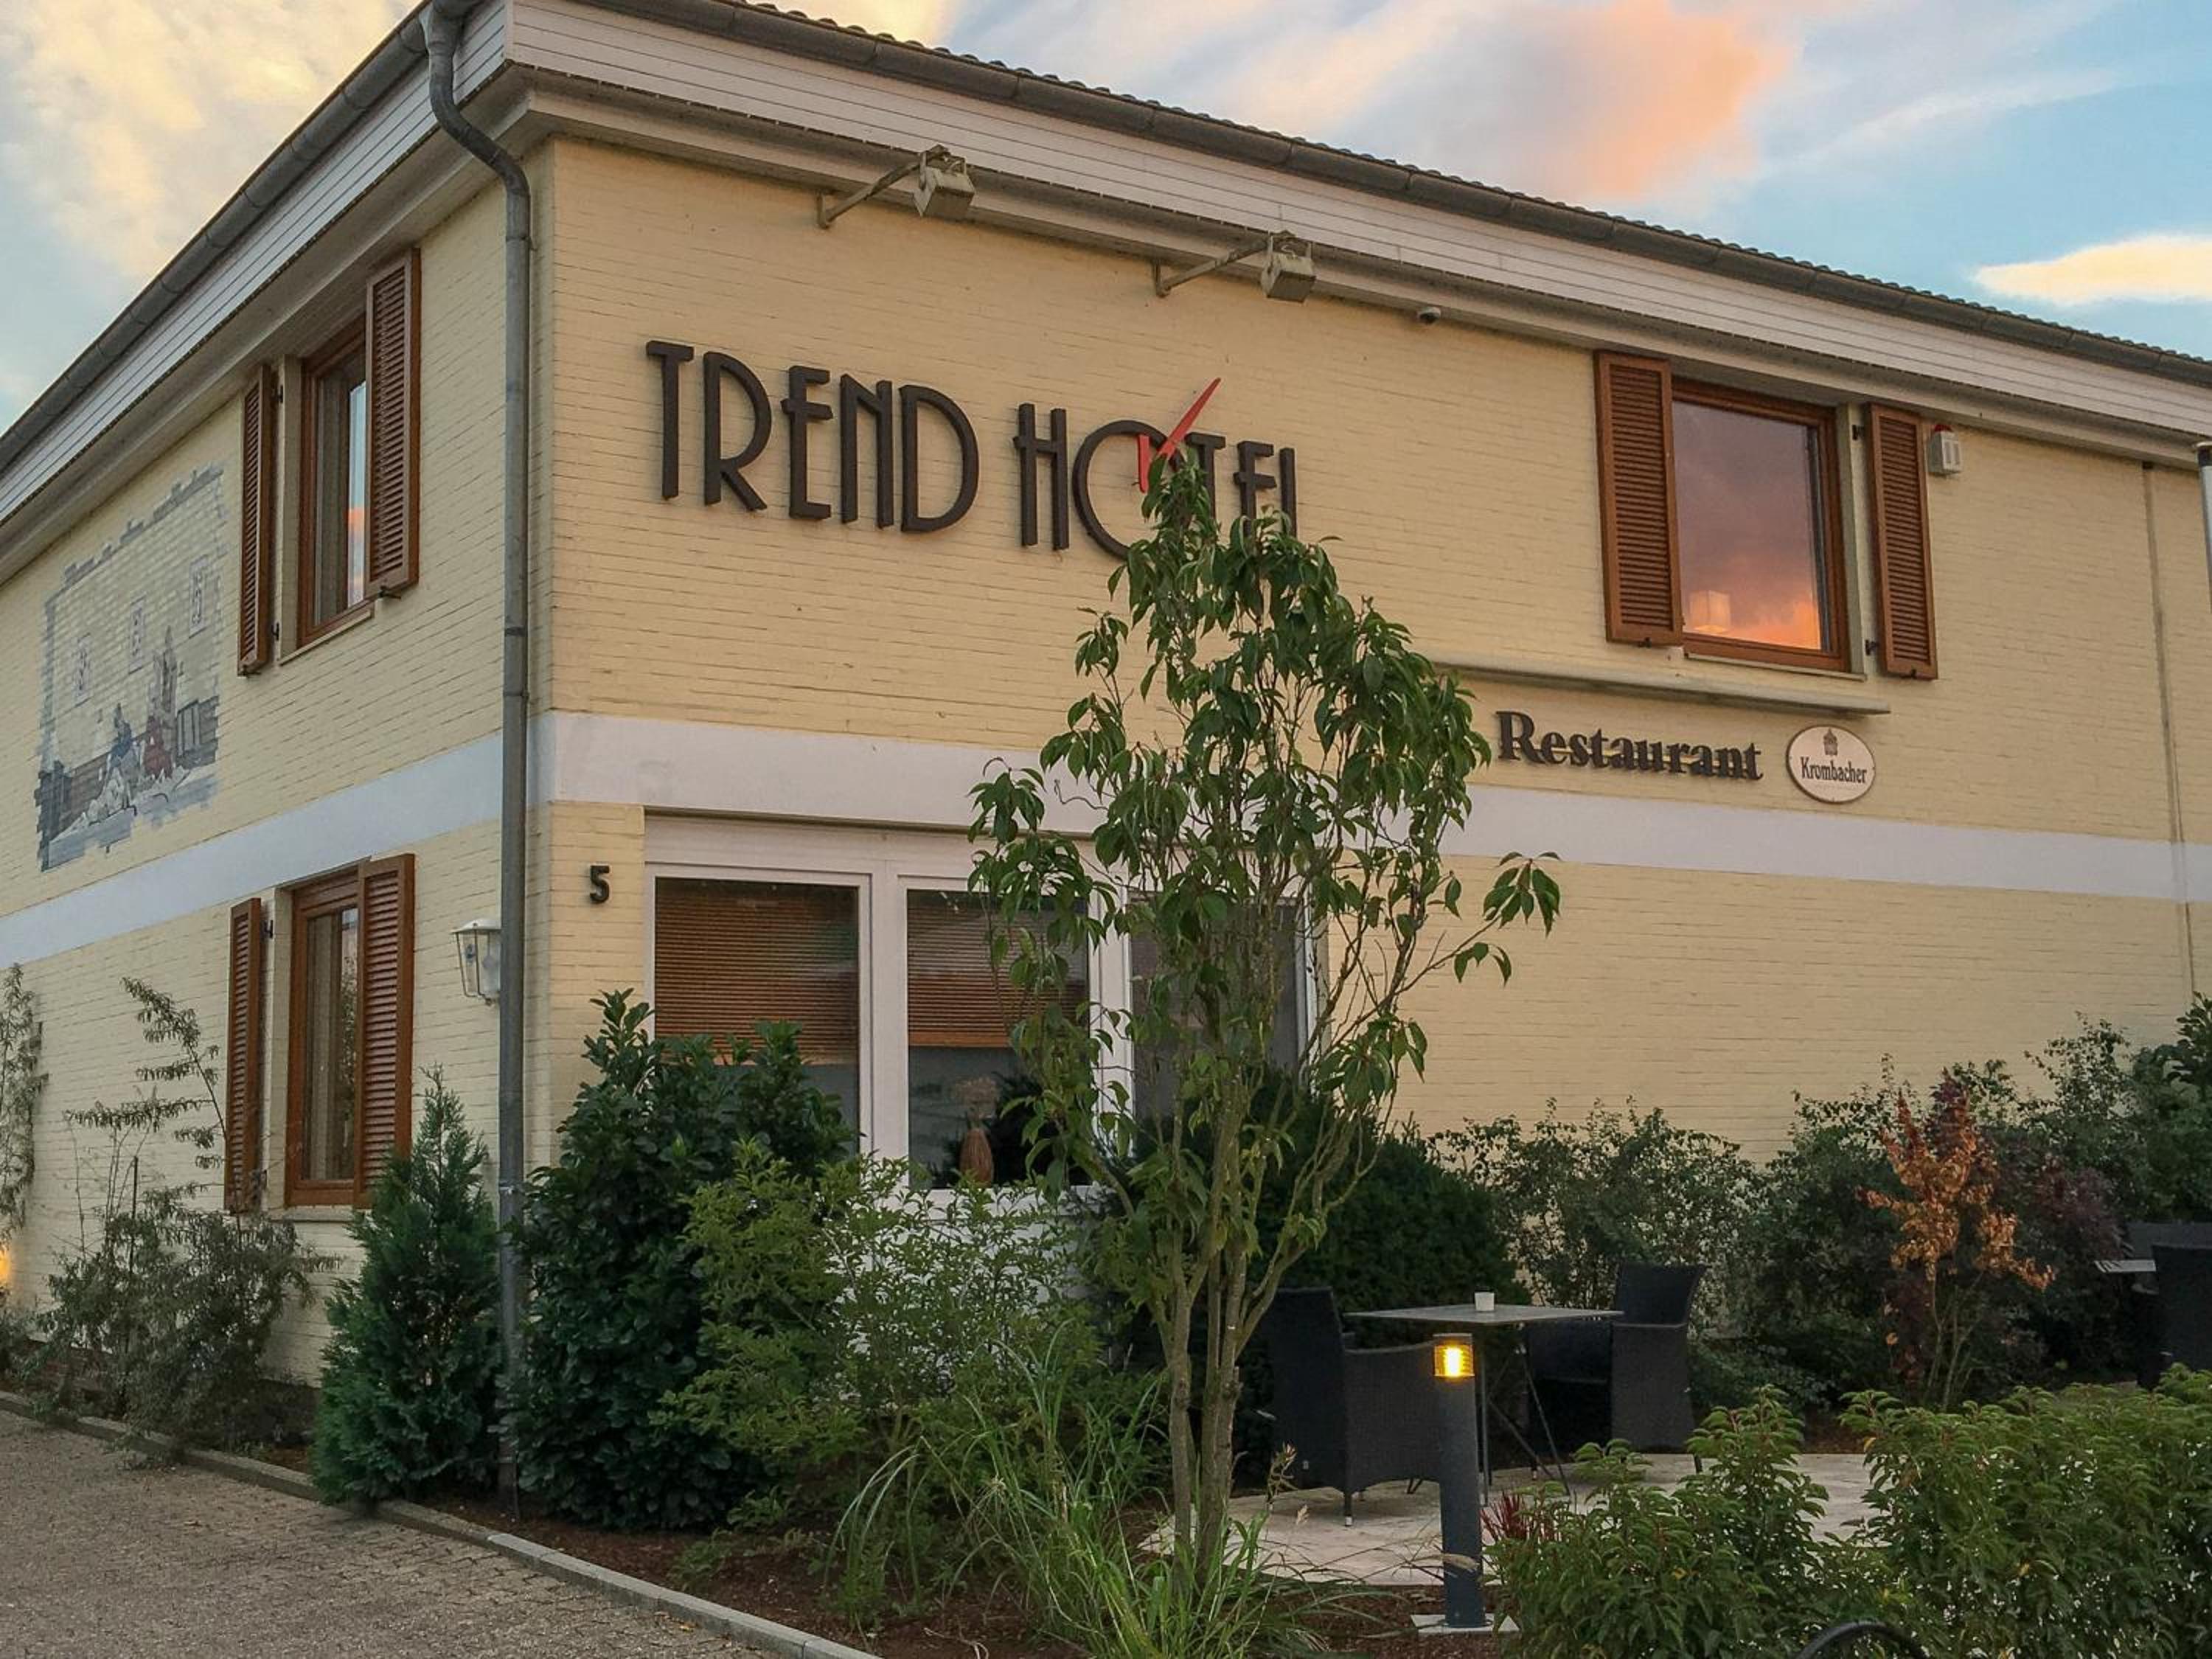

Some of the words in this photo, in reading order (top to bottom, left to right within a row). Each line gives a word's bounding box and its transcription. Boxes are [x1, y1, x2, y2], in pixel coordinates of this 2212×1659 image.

[646, 341, 980, 532] TREND
[1495, 711, 1764, 780] Restaurant
[1800, 757, 1868, 783] Krombacher
[589, 865, 610, 905] 5
